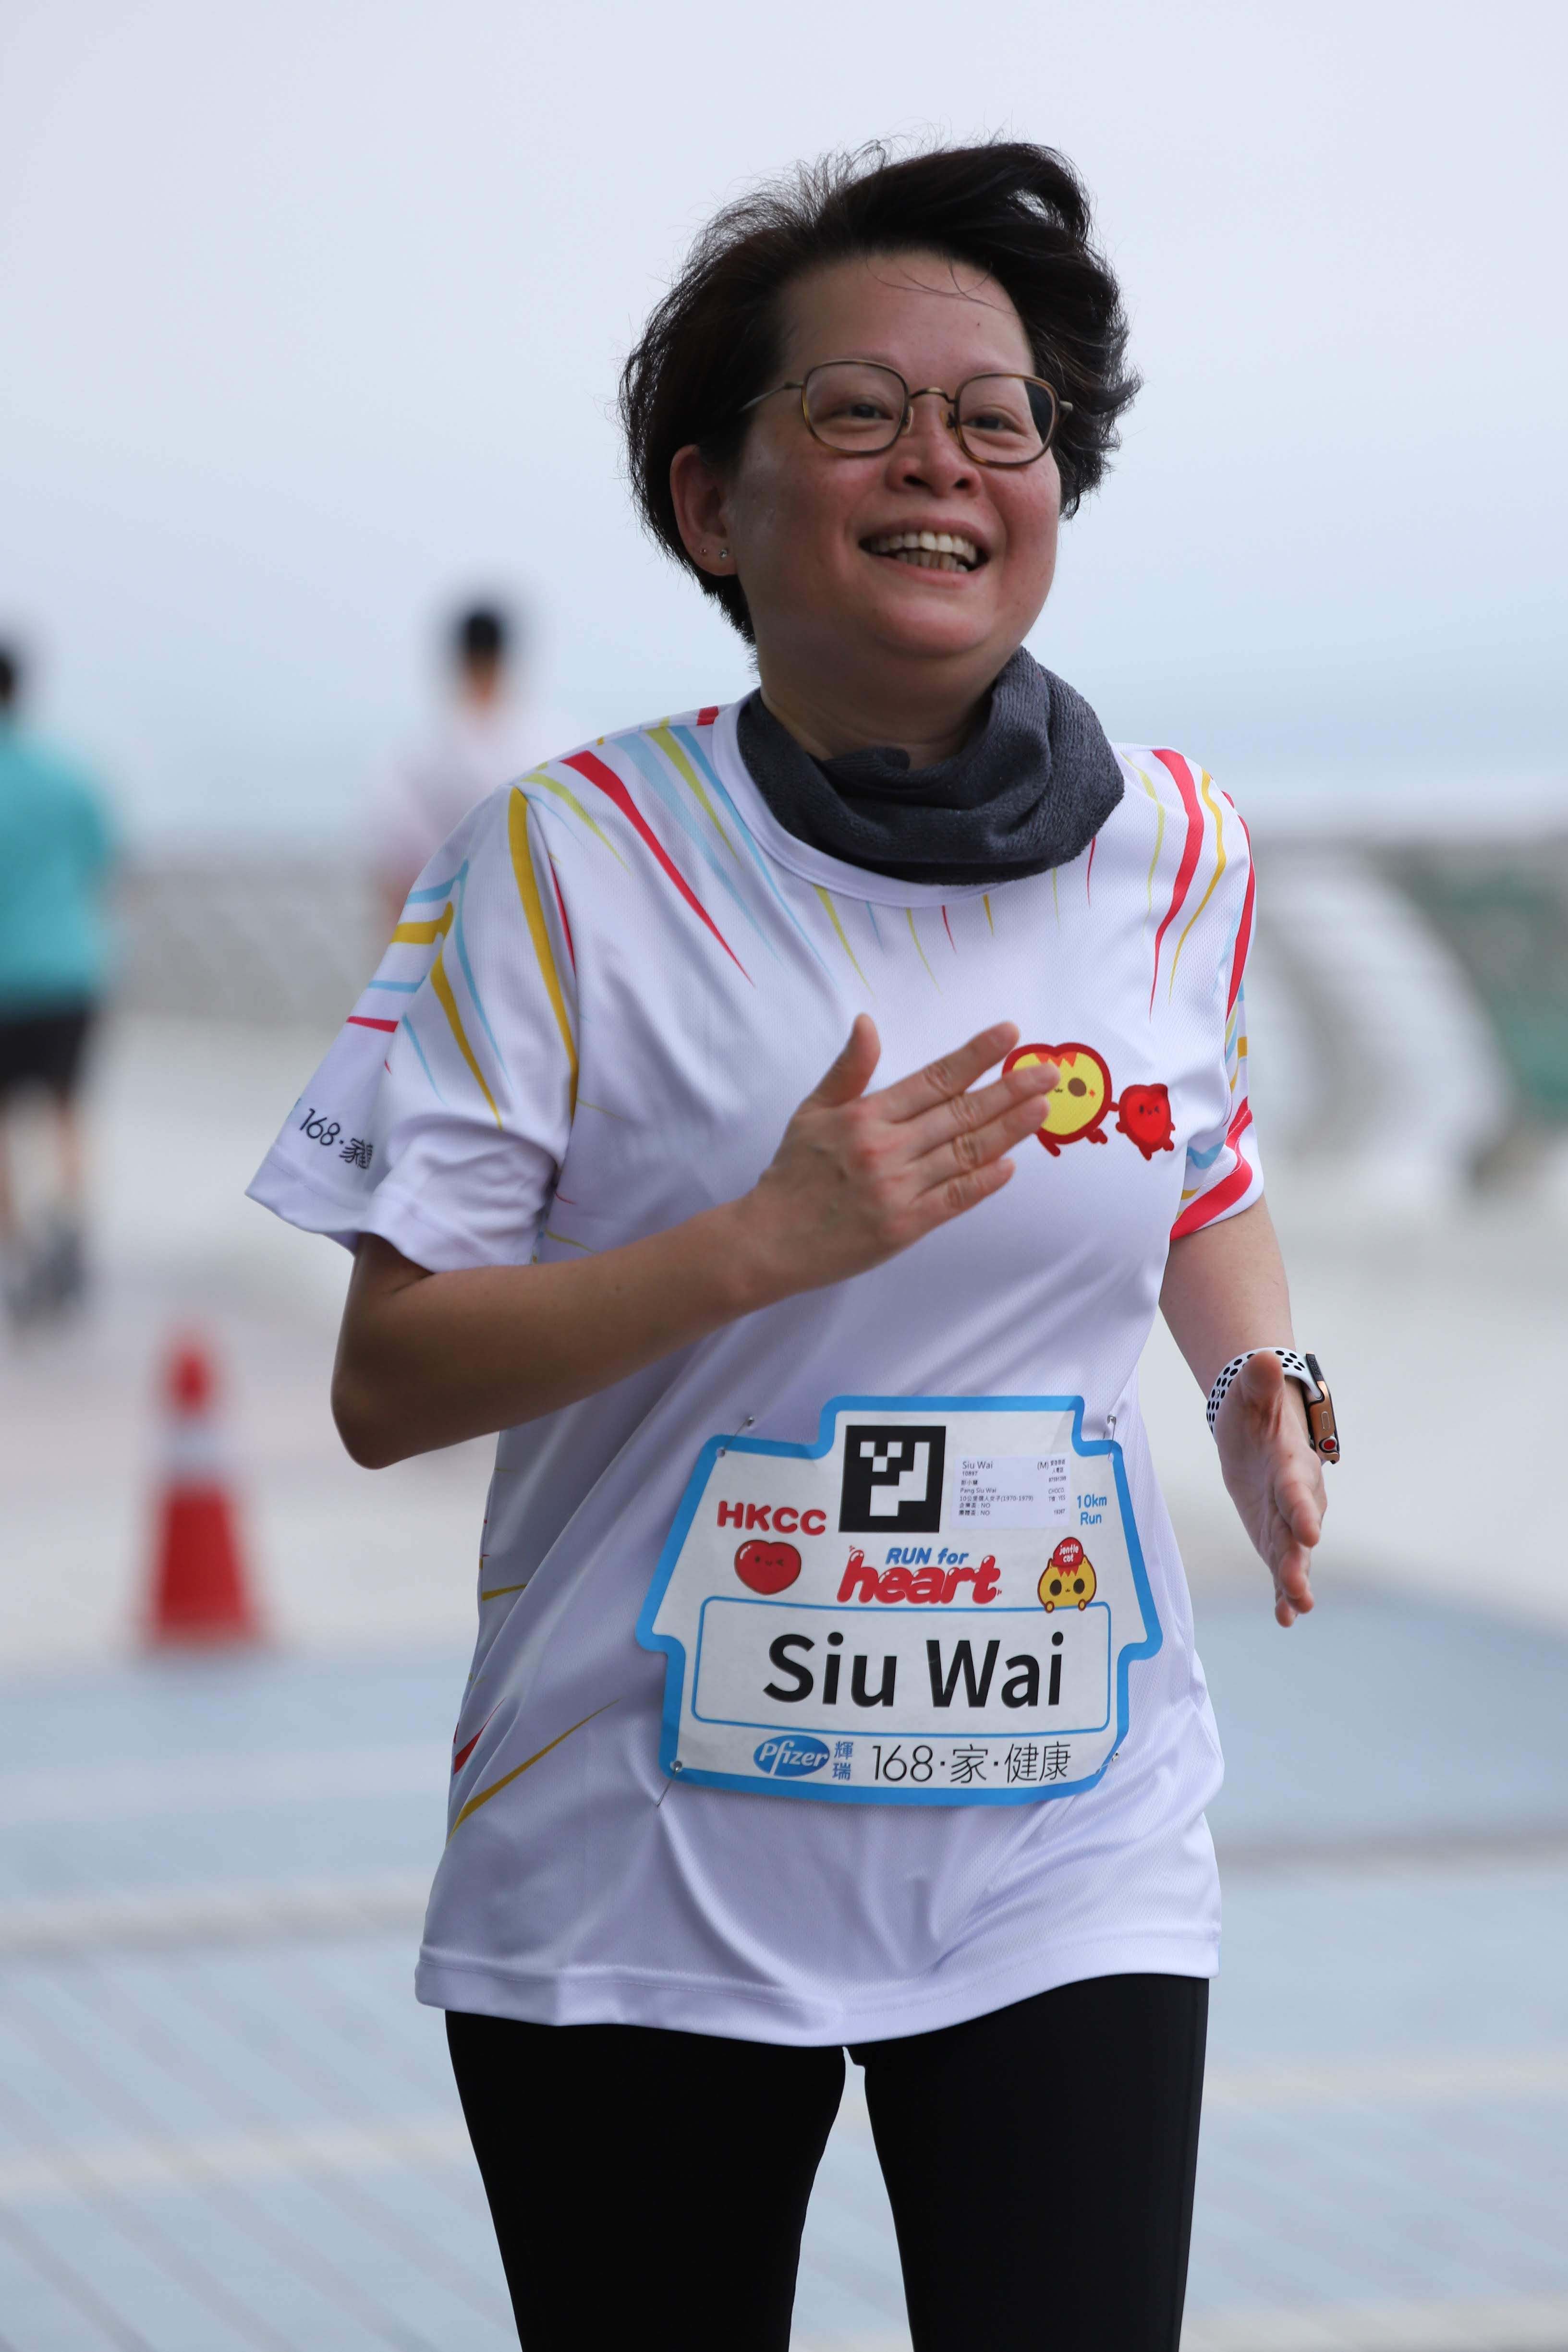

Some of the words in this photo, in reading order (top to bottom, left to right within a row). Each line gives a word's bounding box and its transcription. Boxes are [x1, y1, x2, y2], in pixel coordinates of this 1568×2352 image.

[962, 1460, 974, 1469] Siu
[977, 1461, 993, 1469] Wai
[1037, 1461, 1049, 1471] (M)
[1077, 1494, 1107, 1509] 10km
[717, 1501, 827, 1536] HKCC
[1081, 1512, 1102, 1526] Run
[885, 1547, 932, 1565] RUN
[937, 1547, 970, 1565] for
[1059, 1543, 1079, 1556] jentle
[1063, 1554, 1074, 1563] cat
[837, 1549, 1001, 1604] heart
[763, 1632, 897, 1707] Siu
[926, 1632, 1064, 1707] Wai
[758, 1739, 828, 1776] Pfizer
